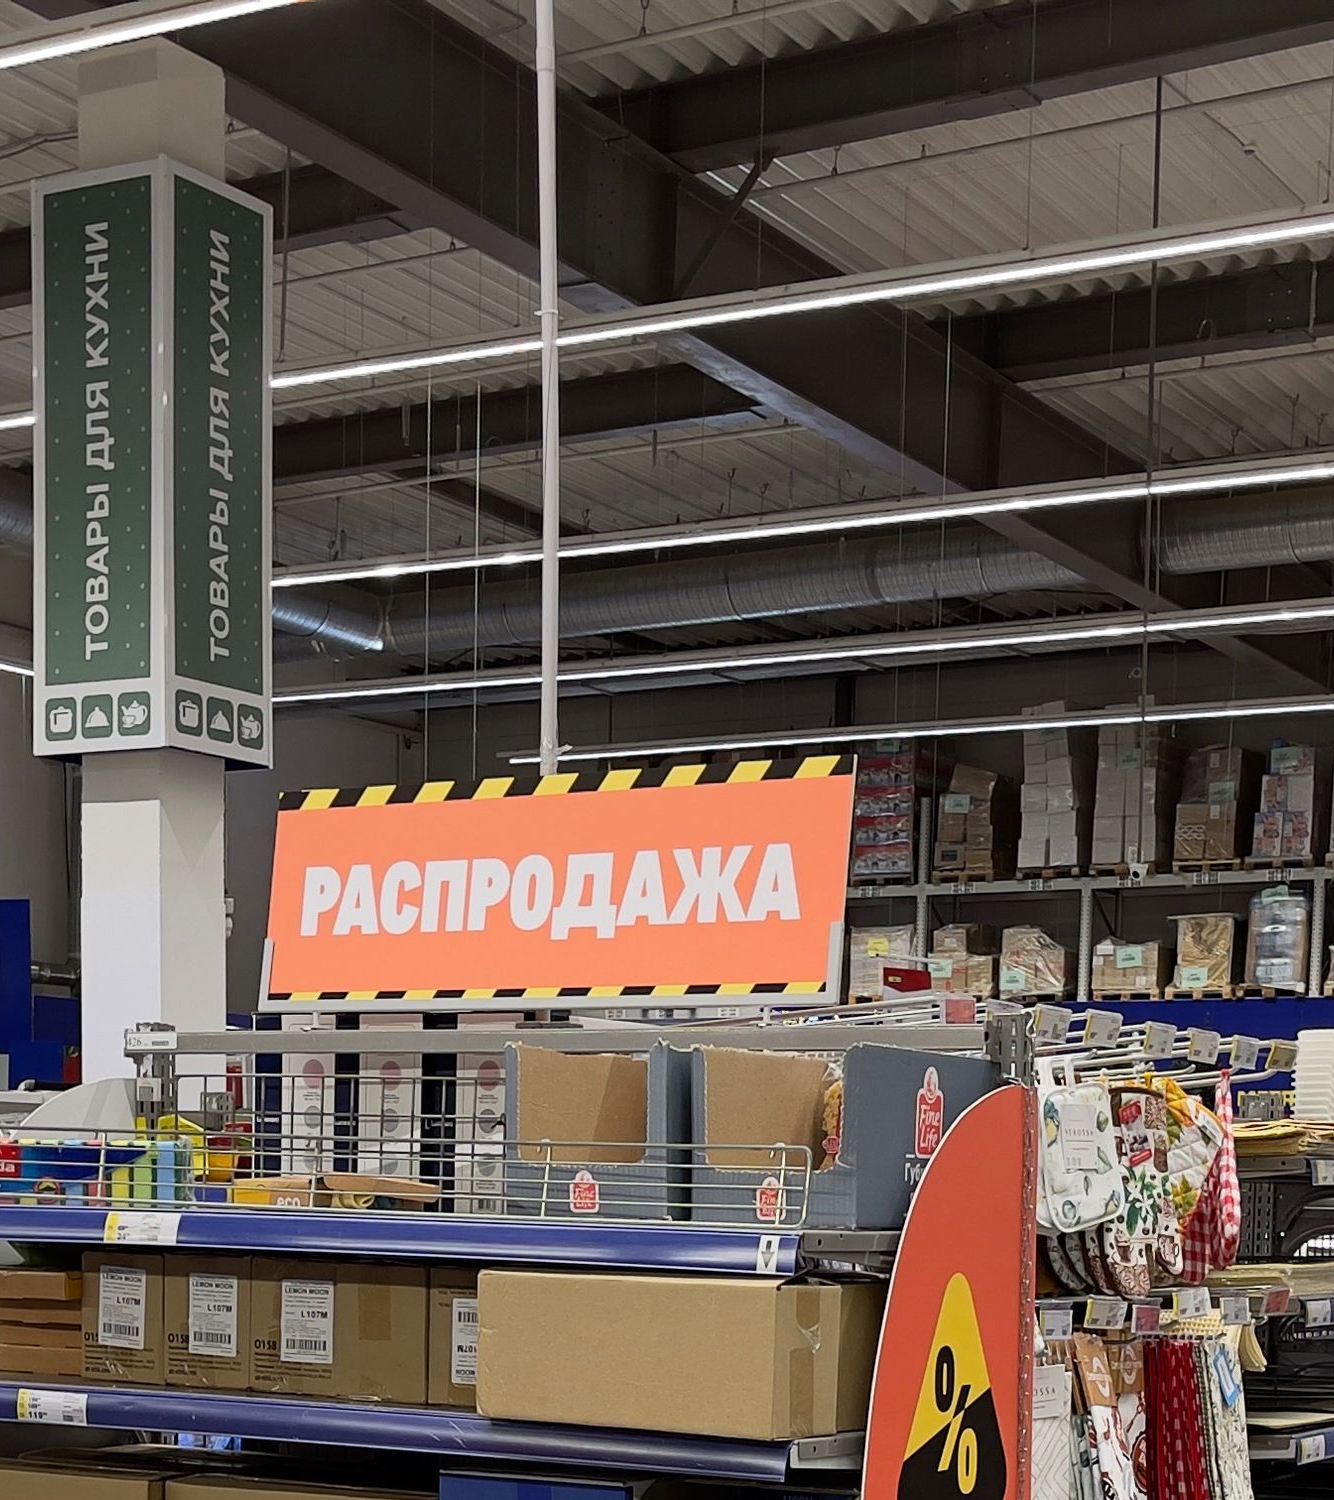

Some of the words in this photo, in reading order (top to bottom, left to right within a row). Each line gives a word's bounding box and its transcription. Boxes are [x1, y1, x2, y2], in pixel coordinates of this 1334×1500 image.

[85, 221, 110, 369] КУХНИ
[209, 228, 231, 377] КУХНИ
[85, 379, 116, 471] ДЛЯ
[209, 389, 234, 482] ДЛЯ
[85, 482, 110, 661] ТОВАРЫ
[209, 487, 231, 662] ТОВАРЫ
[299, 842, 802, 942] РАСПРОДАЖА
[920, 1104, 941, 1127] Fine
[920, 1126, 938, 1152] Life
[276, 1196, 301, 1206] eco
[573, 1187, 596, 1201] Fine
[760, 1193, 778, 1206] Fin
[284, 1286, 307, 1295] LEMON
[308, 1288, 330, 1296] MOON
[300, 1310, 328, 1319] L107M
[84, 1332, 99, 1342] 015
[456, 1344, 478, 1354] 107M
